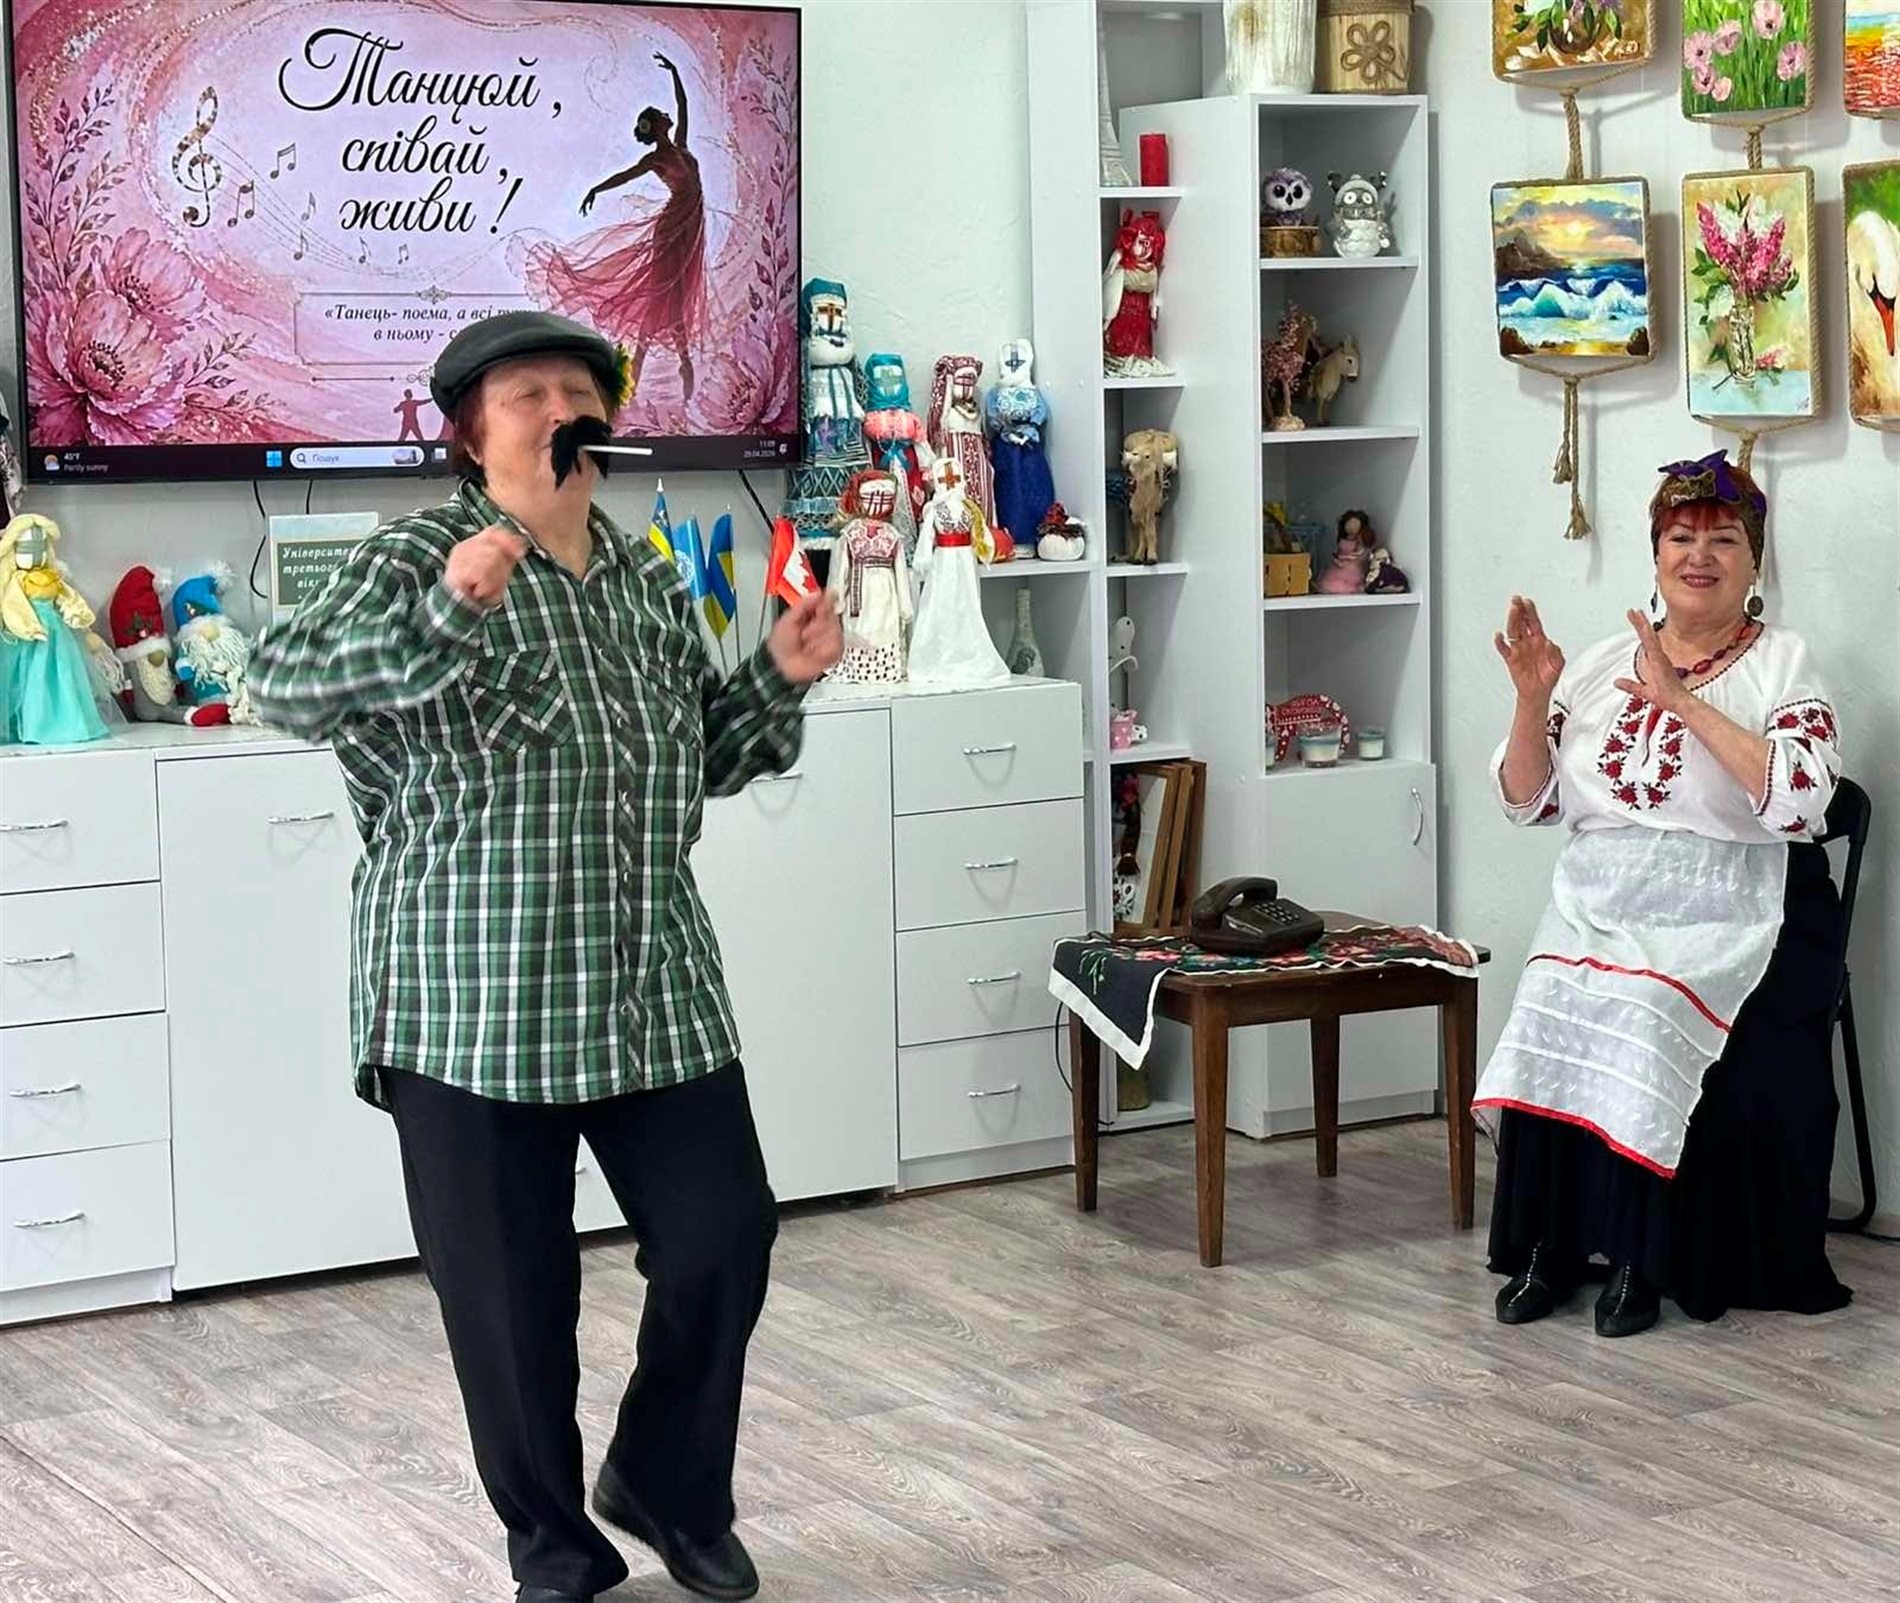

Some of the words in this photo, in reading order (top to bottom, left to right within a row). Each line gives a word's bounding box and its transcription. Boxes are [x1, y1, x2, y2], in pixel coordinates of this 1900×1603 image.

[278, 27, 541, 125] Танцюй
[341, 114, 490, 175] співай
[338, 175, 477, 233] живи
[386, 330, 434, 343] ньому
[282, 547, 353, 559] Університе
[283, 564, 335, 577] третьог
